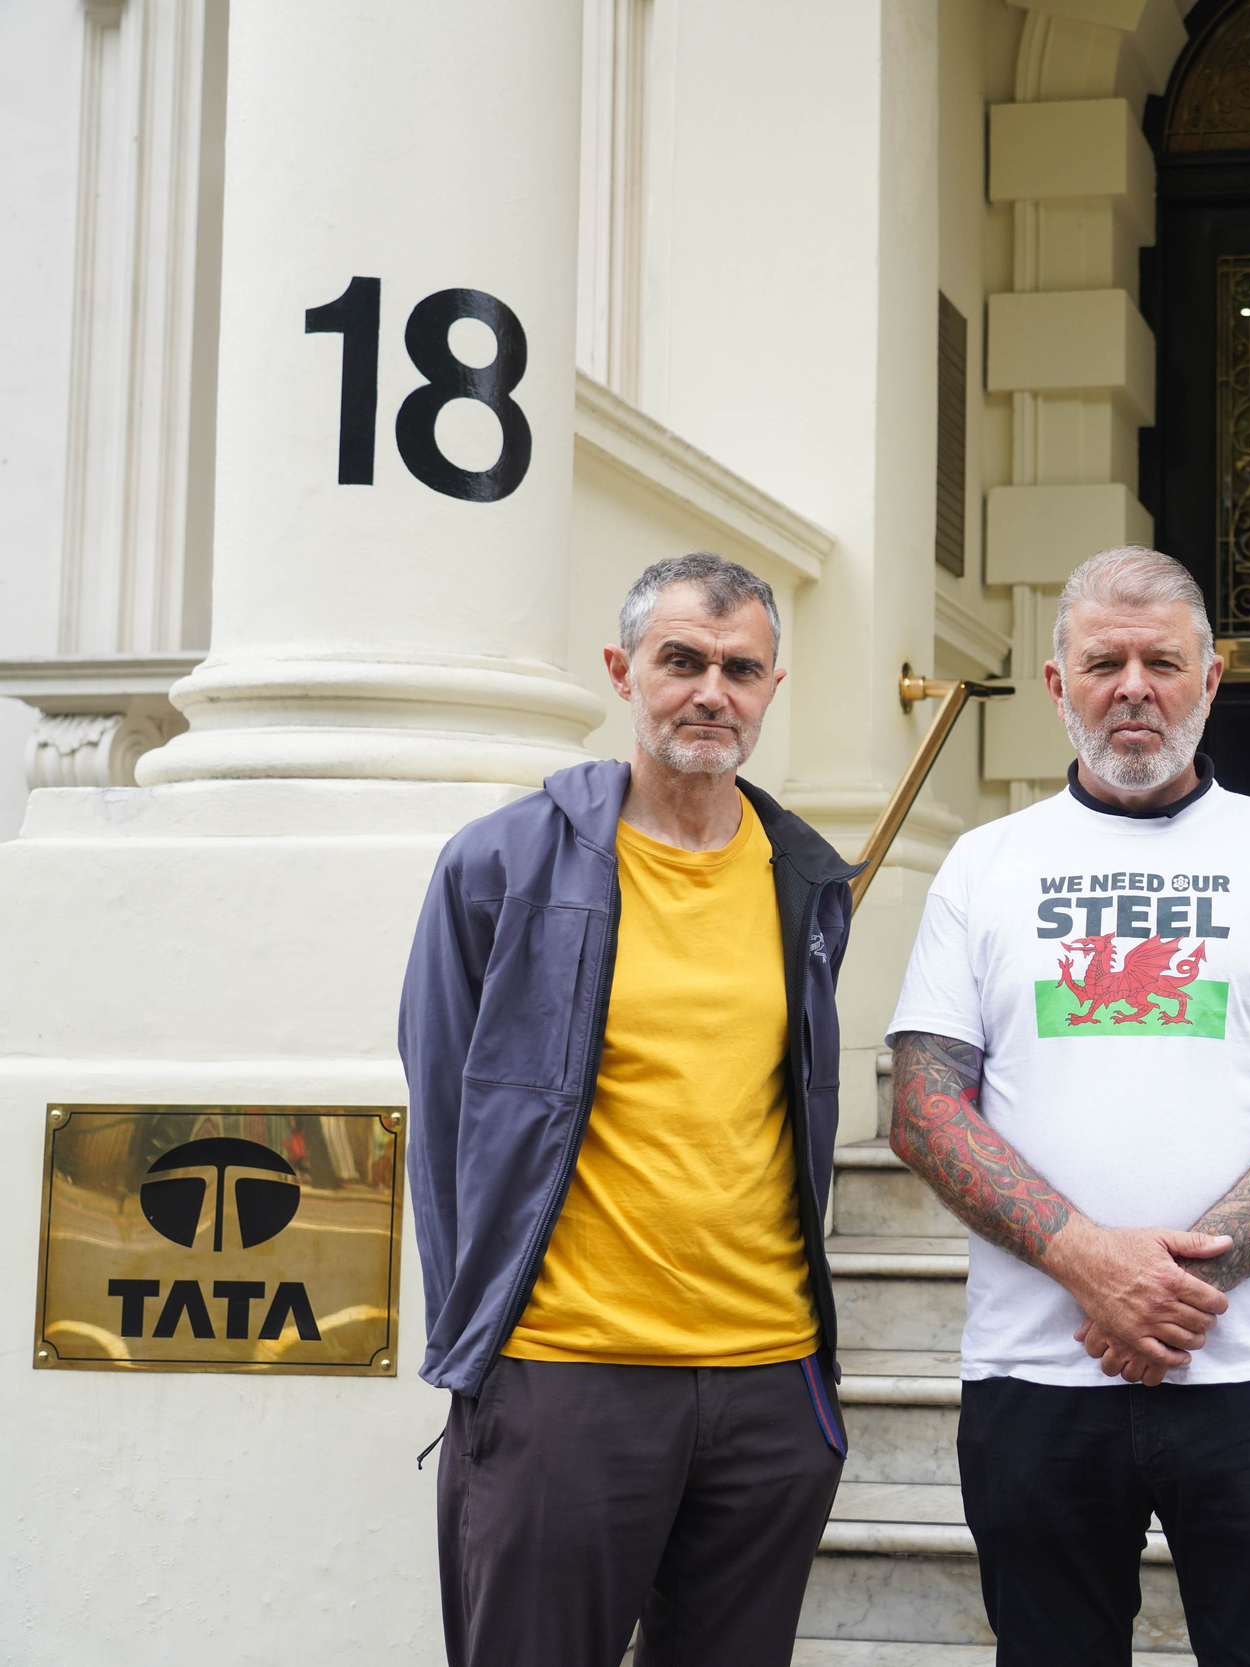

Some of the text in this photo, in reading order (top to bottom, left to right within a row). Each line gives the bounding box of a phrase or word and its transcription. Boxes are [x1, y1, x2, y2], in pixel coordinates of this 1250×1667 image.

[305, 276, 532, 502] 18
[1040, 872, 1230, 894] WE NEED OUR
[1036, 895, 1230, 939] STEEL
[107, 1278, 322, 1341] TATA
